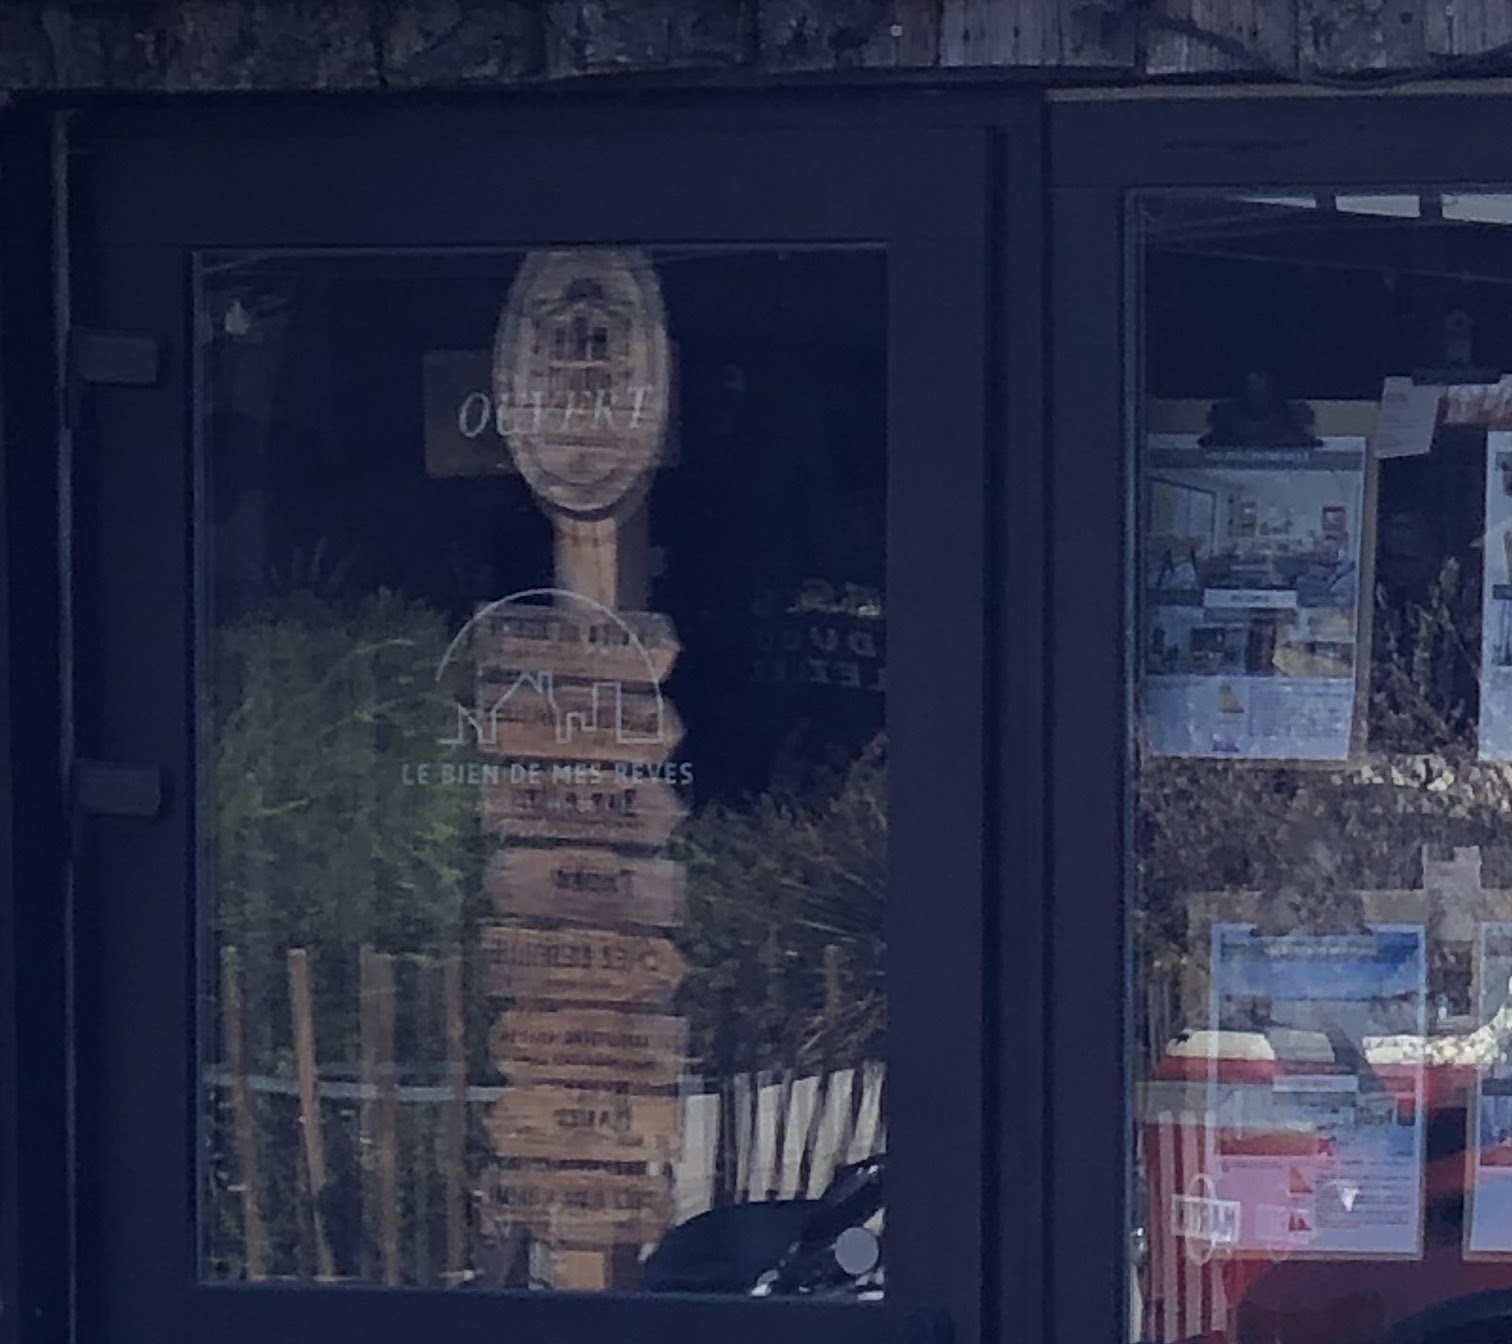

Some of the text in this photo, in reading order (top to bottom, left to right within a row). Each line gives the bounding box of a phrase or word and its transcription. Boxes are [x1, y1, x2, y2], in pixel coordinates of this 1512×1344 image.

[401, 763, 430, 786] LE
[441, 763, 499, 786] BIEN
[510, 763, 541, 785] DE
[552, 763, 601, 785] MES
